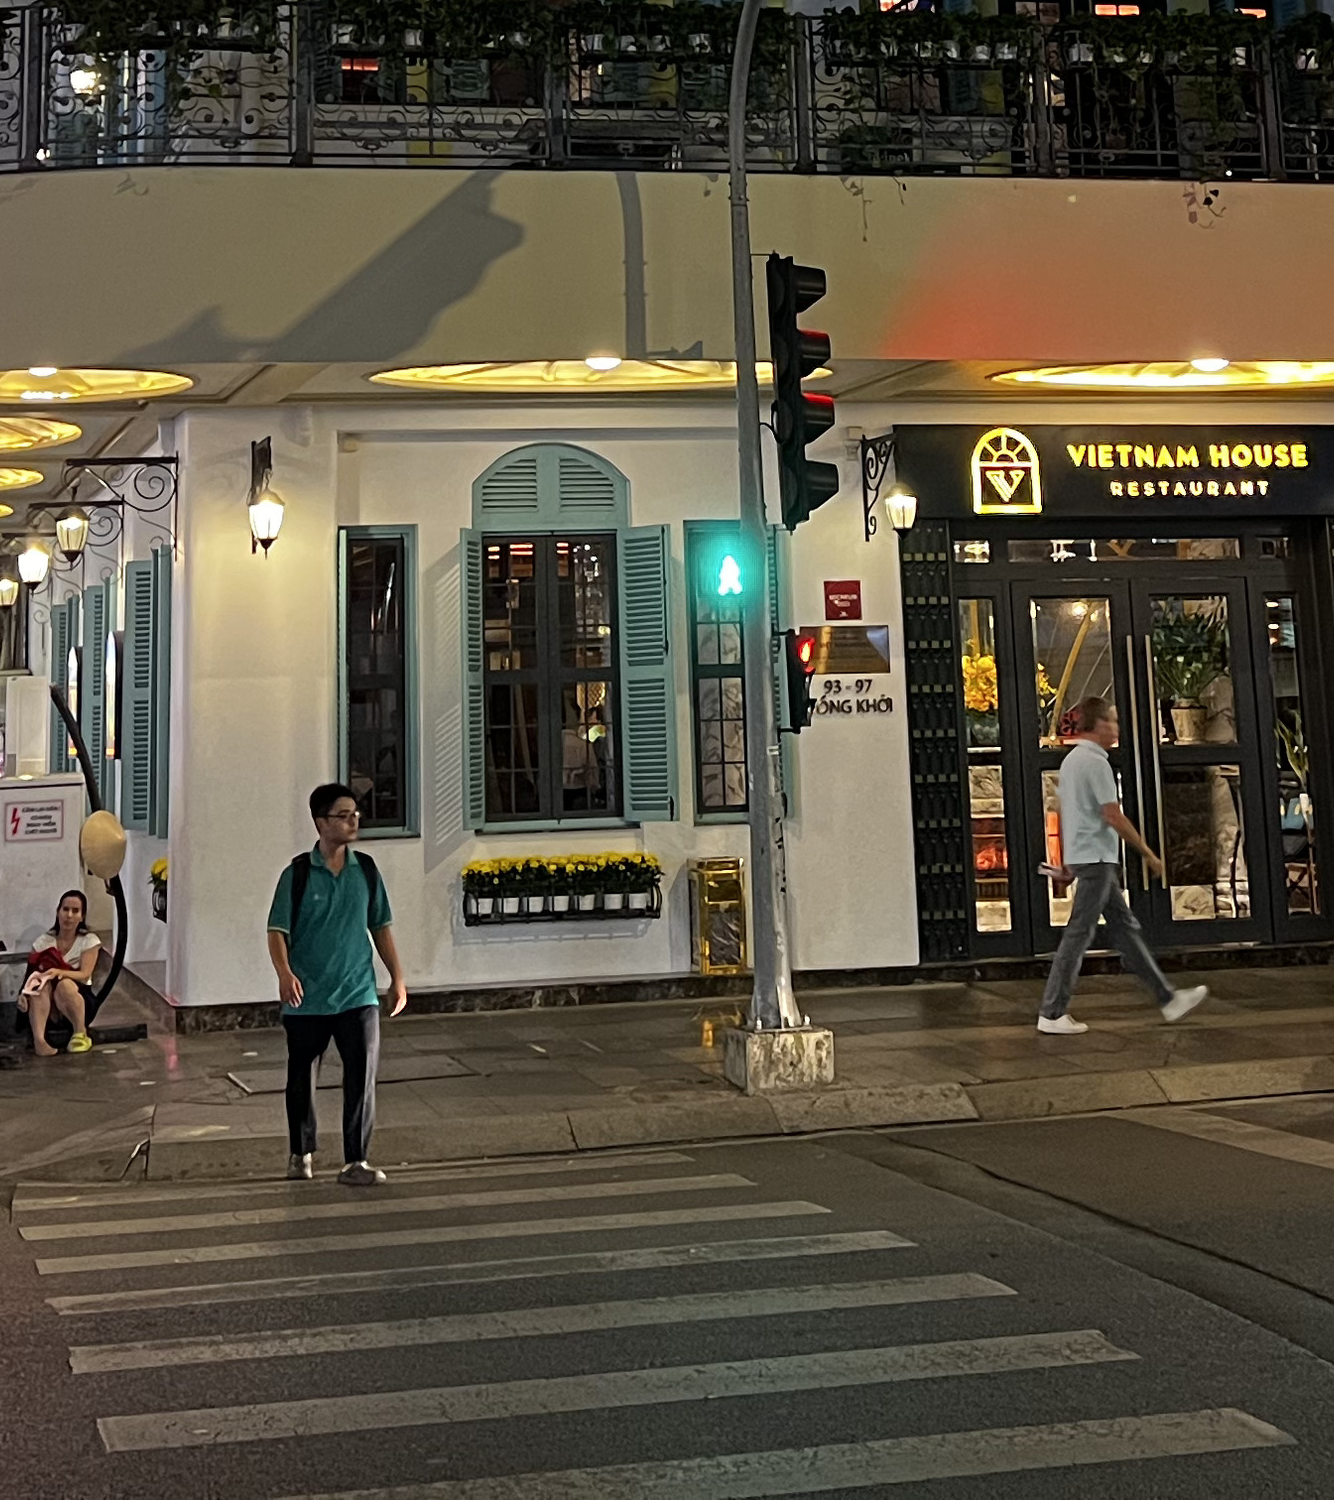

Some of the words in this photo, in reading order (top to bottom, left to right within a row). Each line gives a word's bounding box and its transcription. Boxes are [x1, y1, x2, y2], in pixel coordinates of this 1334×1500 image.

[1066, 443, 1200, 468] VIETNAM
[1209, 442, 1309, 468] HOUSE
[1110, 480, 1269, 497] RESTAURANT
[823, 679, 842, 694] 93
[855, 678, 873, 694] 97
